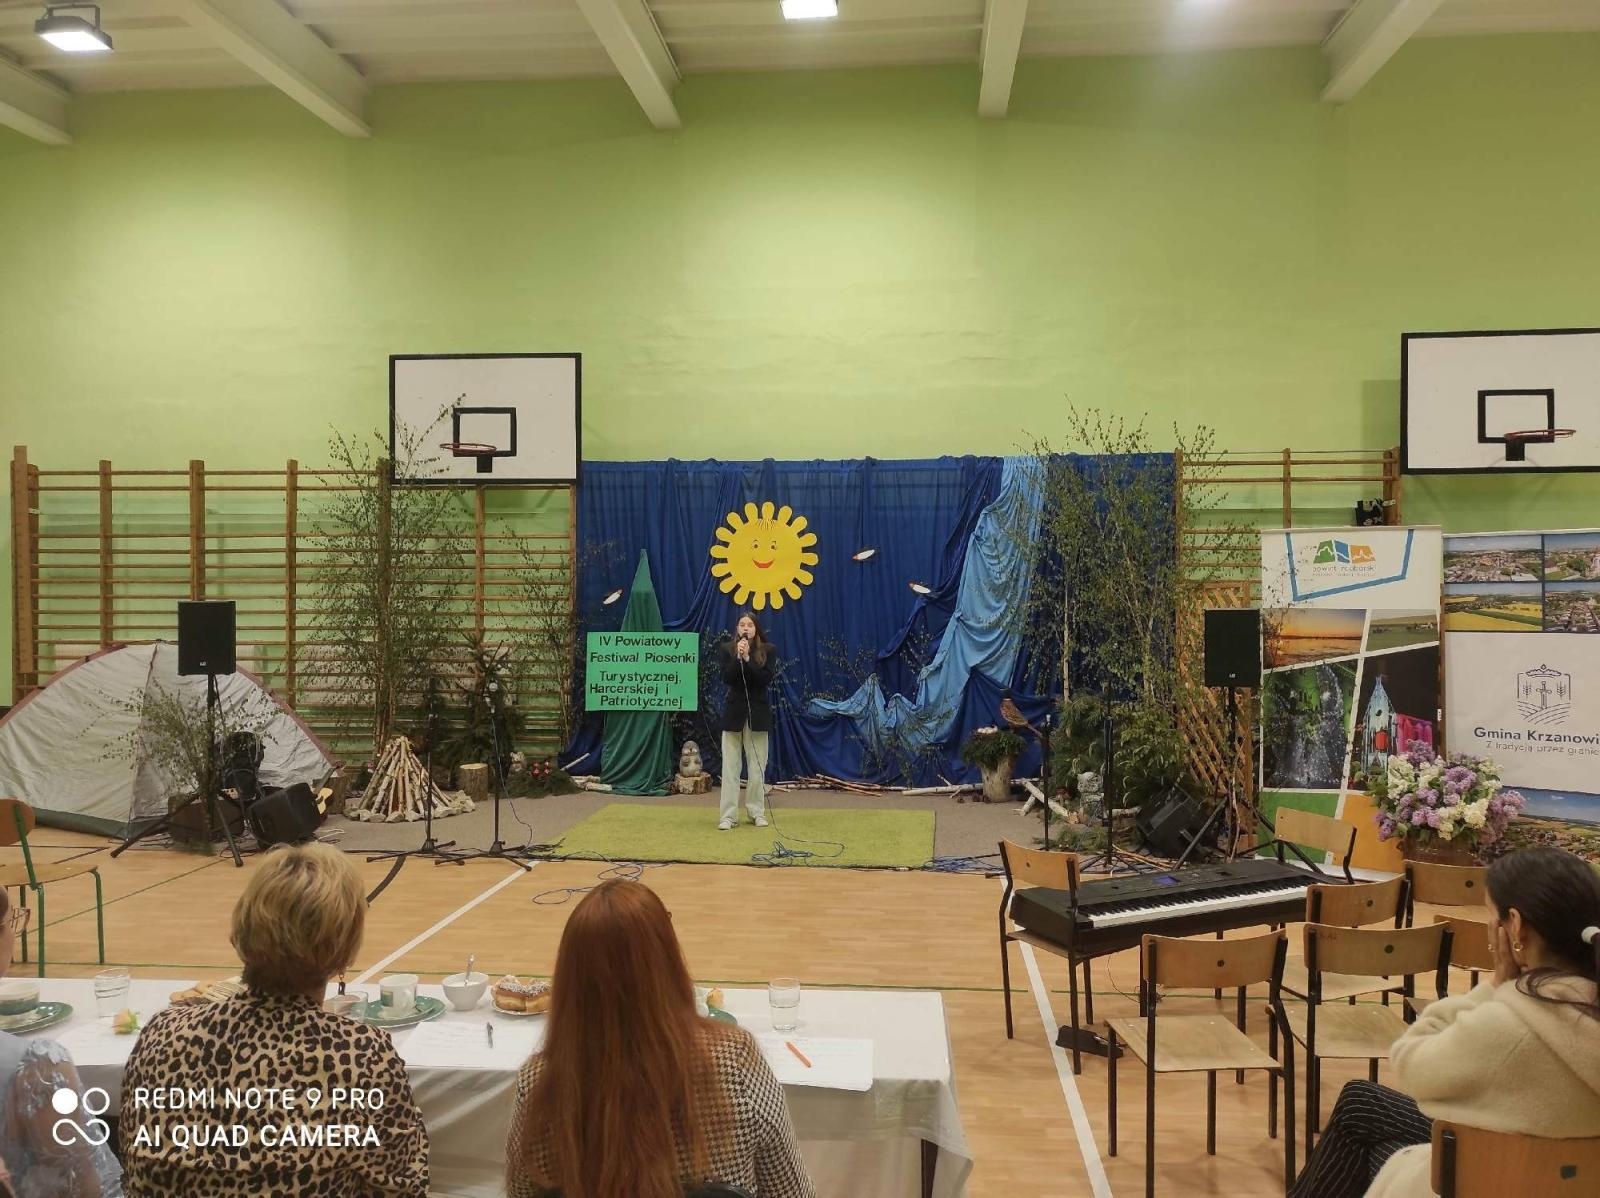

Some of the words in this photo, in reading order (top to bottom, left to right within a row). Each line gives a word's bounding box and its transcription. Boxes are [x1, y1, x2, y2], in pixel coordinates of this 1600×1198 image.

[599, 635, 611, 646] IV
[615, 635, 681, 649] Powiatowy
[590, 652, 639, 663] Festiwal
[645, 652, 696, 664] Piosenki
[599, 670, 682, 685] Turystycznej,
[590, 683, 659, 697] Harcerskiej
[665, 684, 669, 694] i
[600, 695, 683, 710] Patriotycznej
[1473, 726, 1521, 740] Gmina
[1527, 729, 1600, 745] Krzanowi
